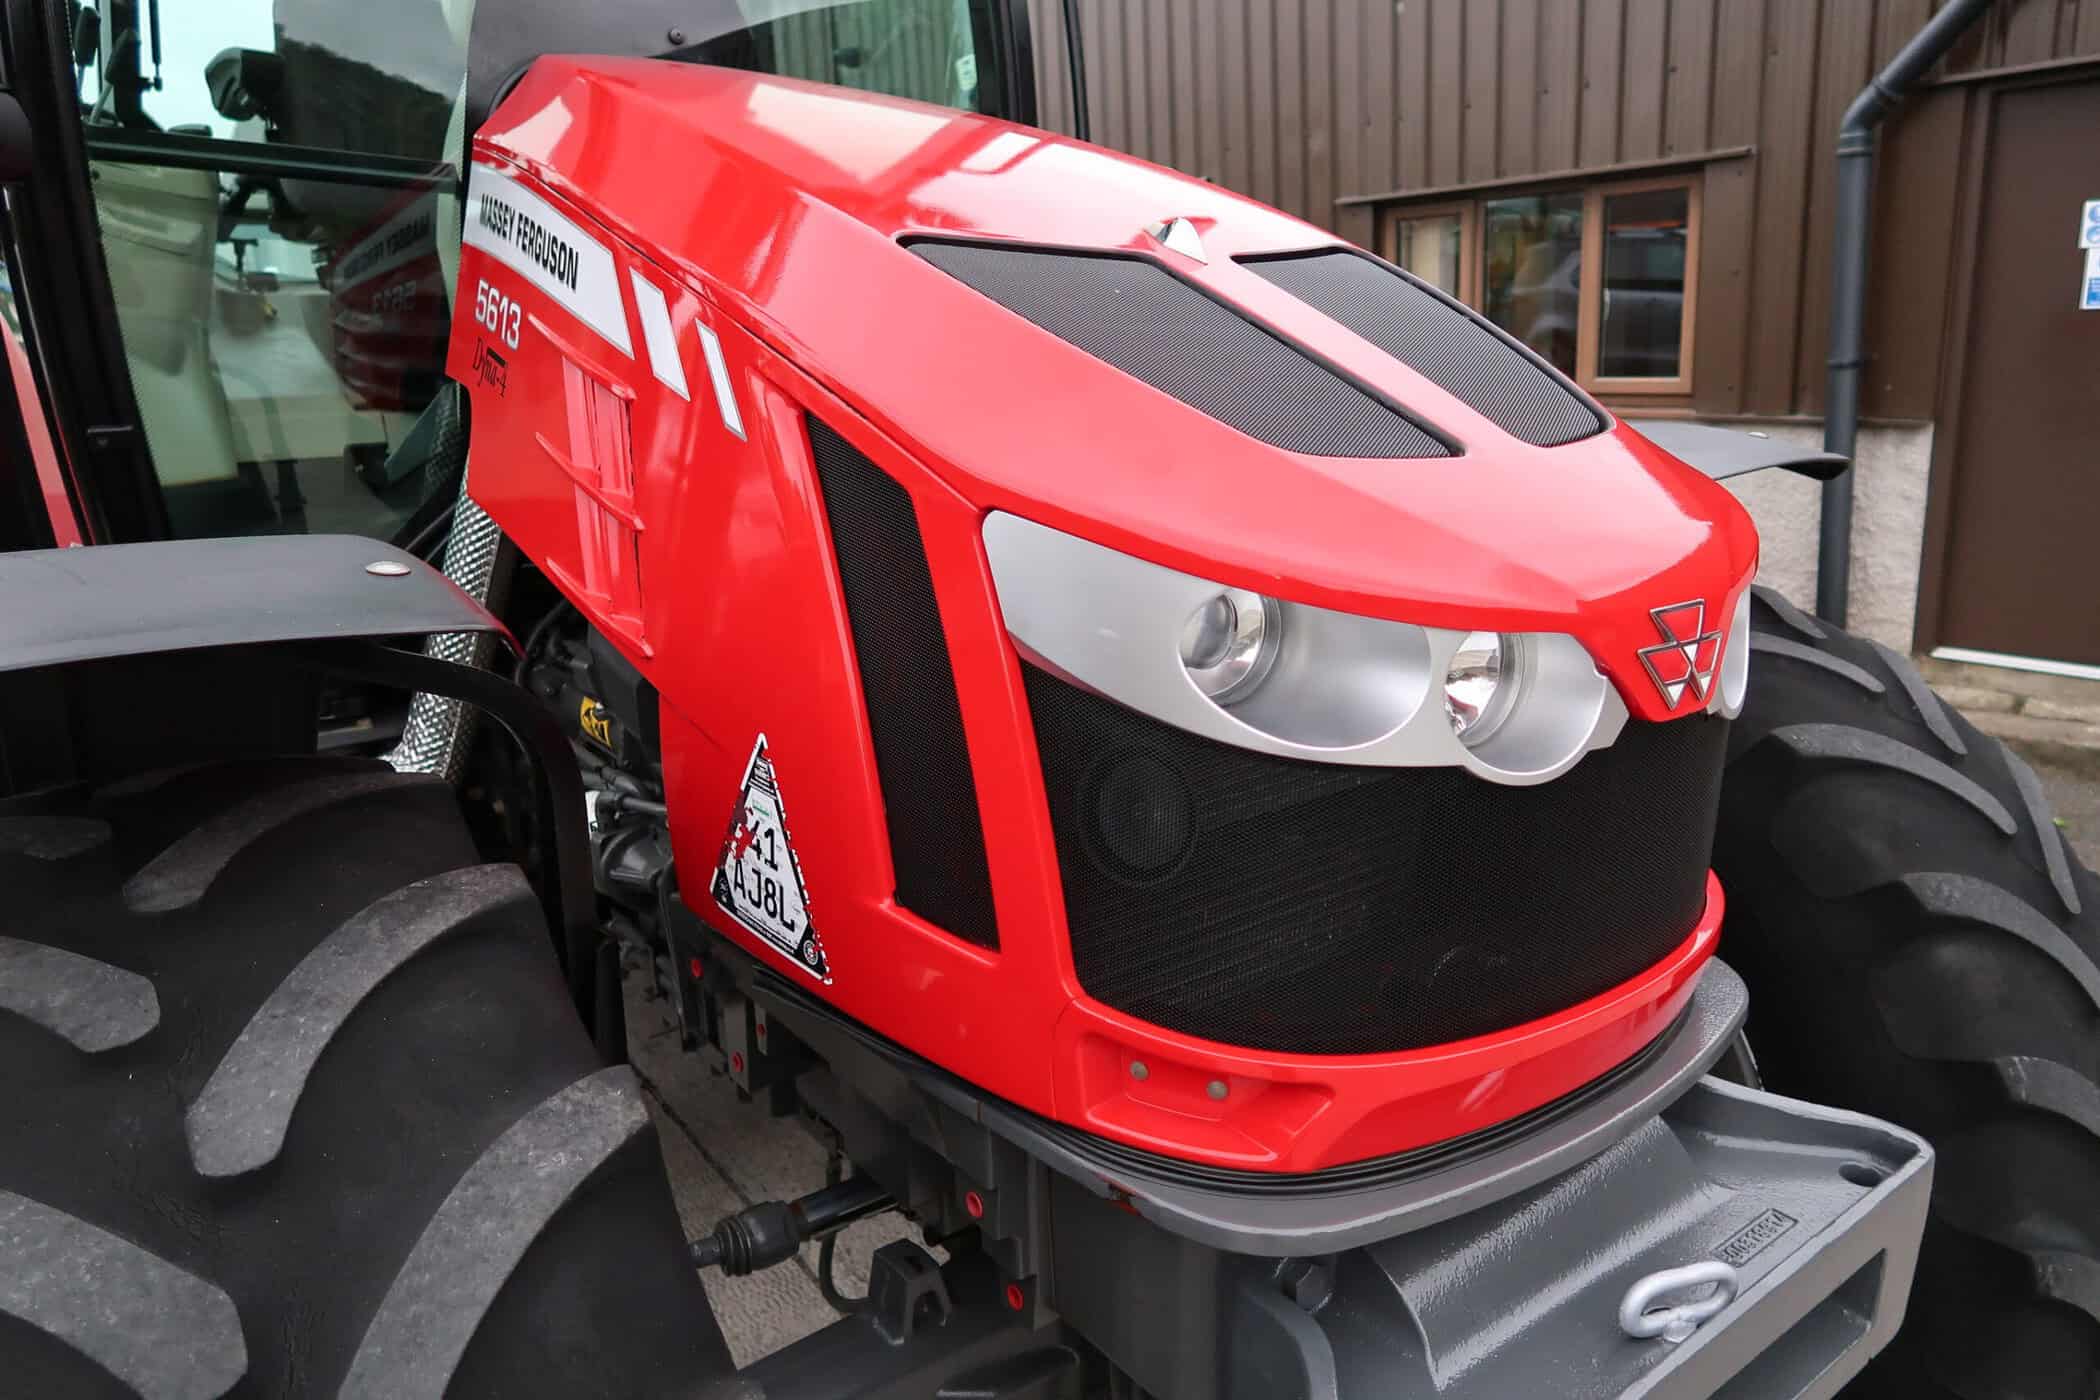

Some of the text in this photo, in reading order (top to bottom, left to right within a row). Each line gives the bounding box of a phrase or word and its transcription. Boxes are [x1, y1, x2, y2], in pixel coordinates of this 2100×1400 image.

[480, 193, 579, 292] MASSEY FERGUSON
[475, 279, 521, 351] 5613
[734, 859, 796, 933] AJ8L
